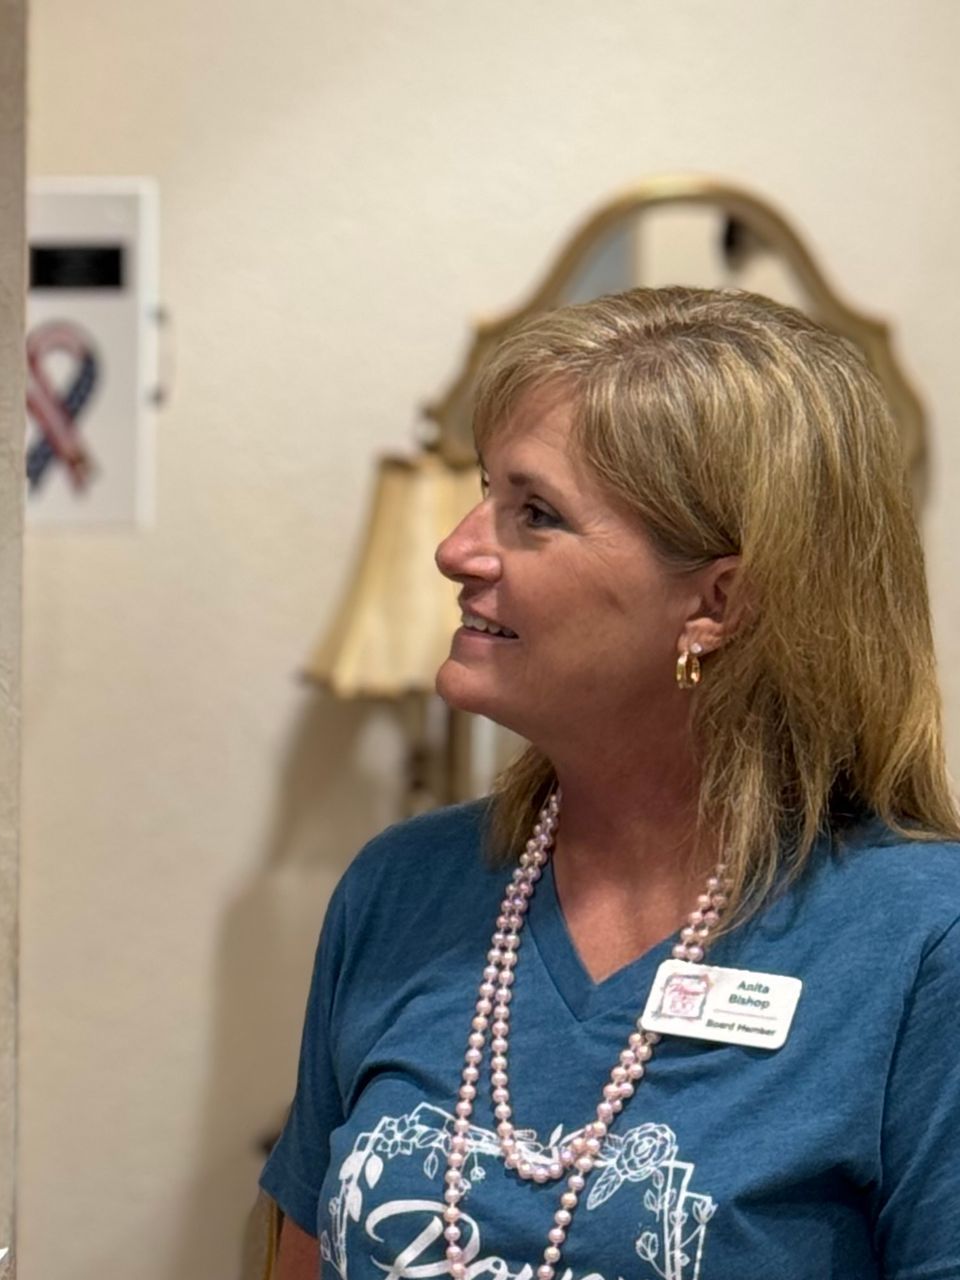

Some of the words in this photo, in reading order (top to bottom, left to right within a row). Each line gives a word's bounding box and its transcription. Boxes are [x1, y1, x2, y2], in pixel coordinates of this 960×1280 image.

[738, 980, 770, 994] Anita
[729, 993, 771, 1009] Bishop
[706, 1019, 735, 1031] Board
[737, 1024, 776, 1036] Member
